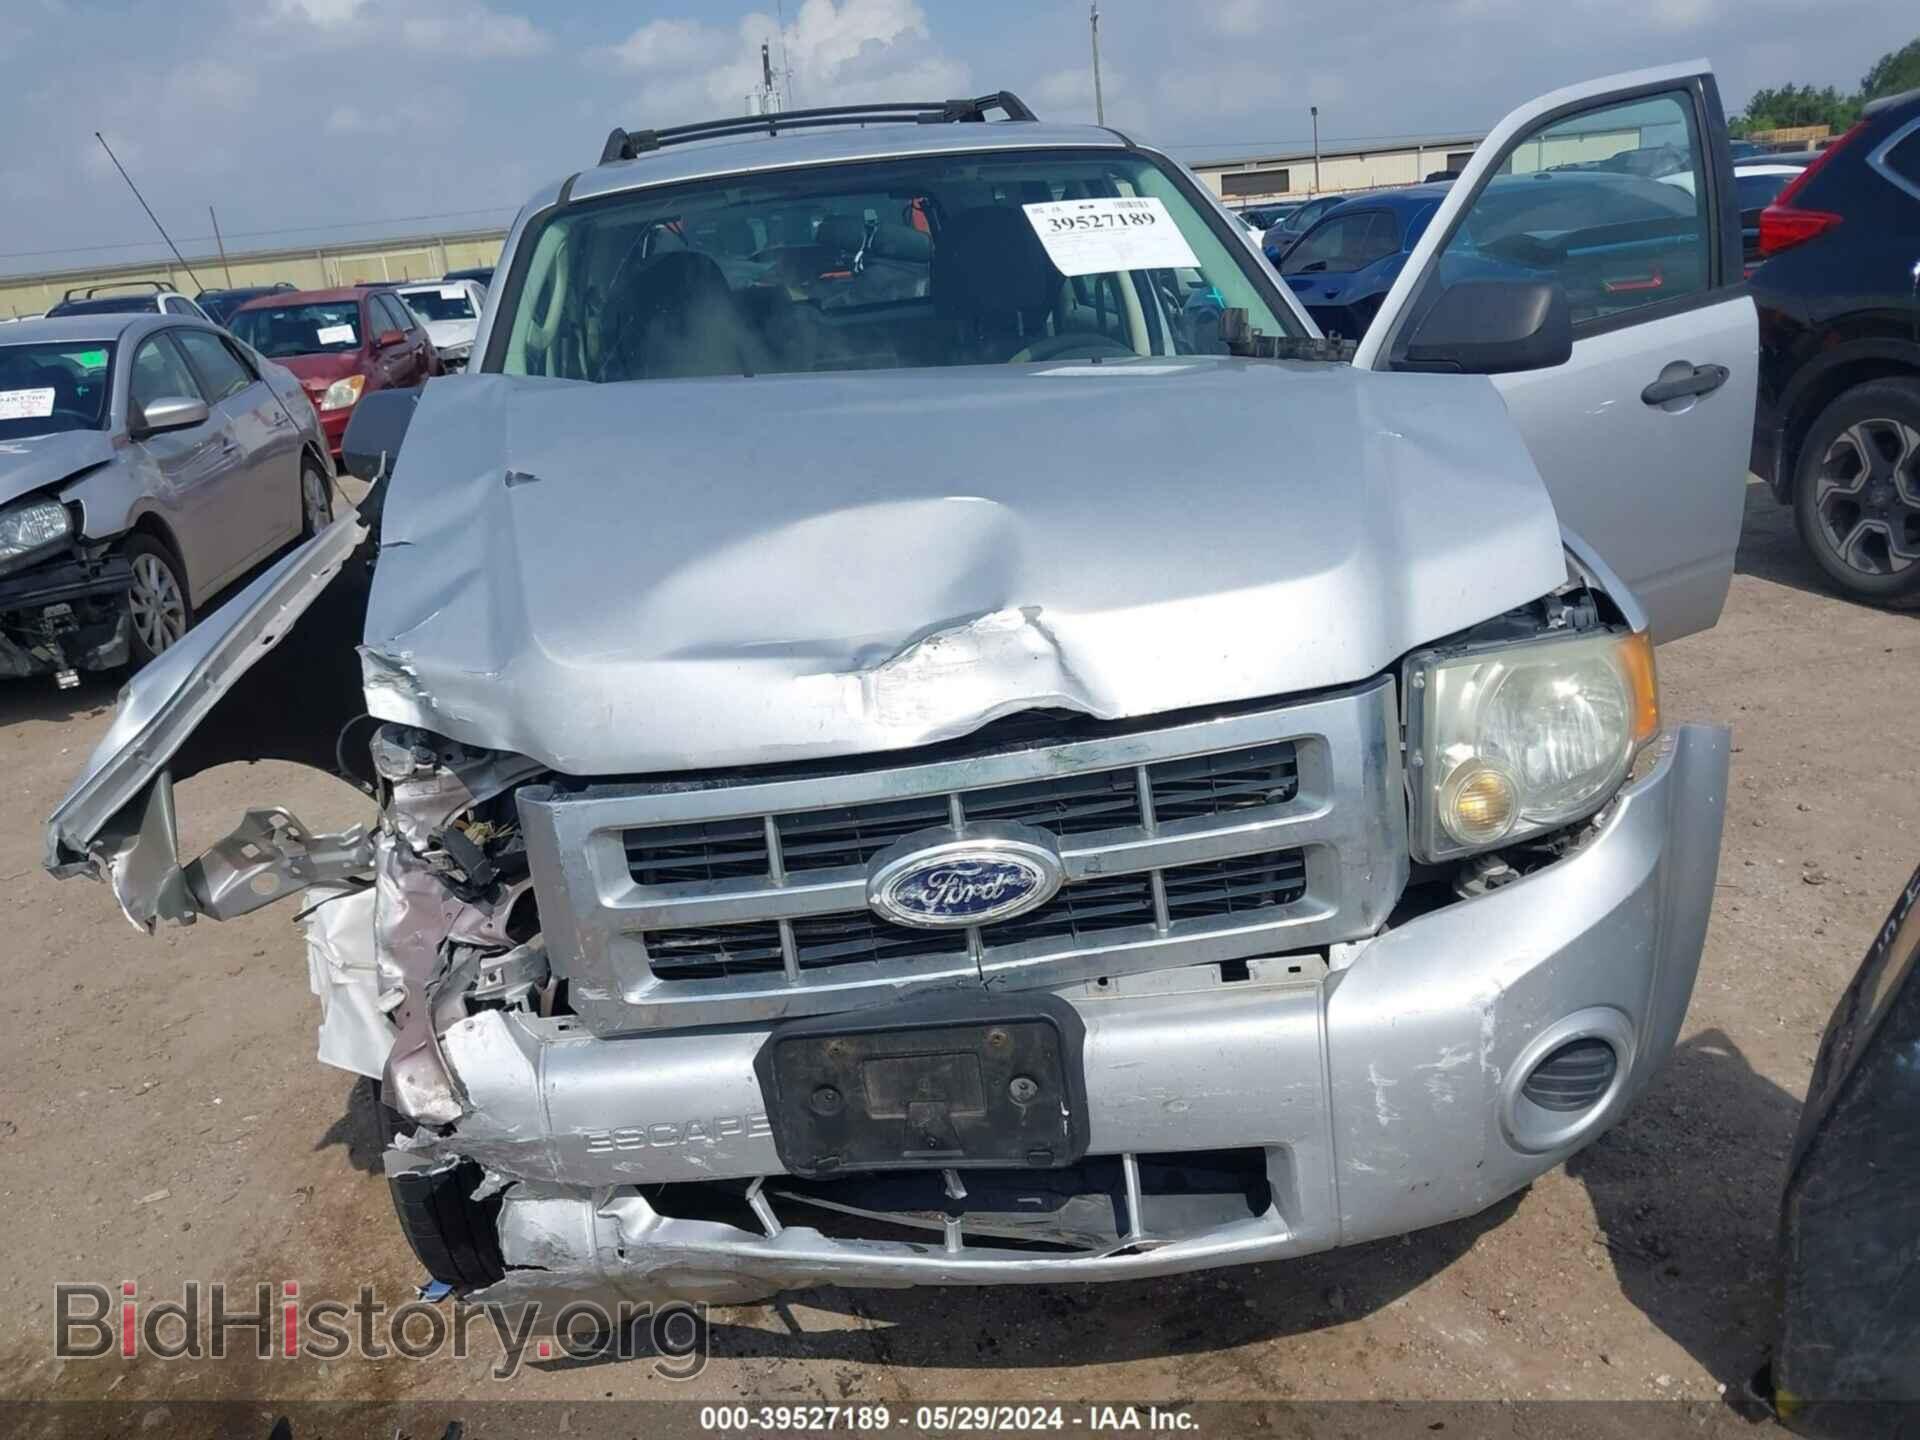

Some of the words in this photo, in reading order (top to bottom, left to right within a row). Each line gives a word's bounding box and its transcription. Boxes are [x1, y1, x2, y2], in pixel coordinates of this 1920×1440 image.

[1048, 212, 1156, 232] 39527189
[921, 866, 1006, 905] Ford
[585, 1113, 772, 1153] ESCAPE
